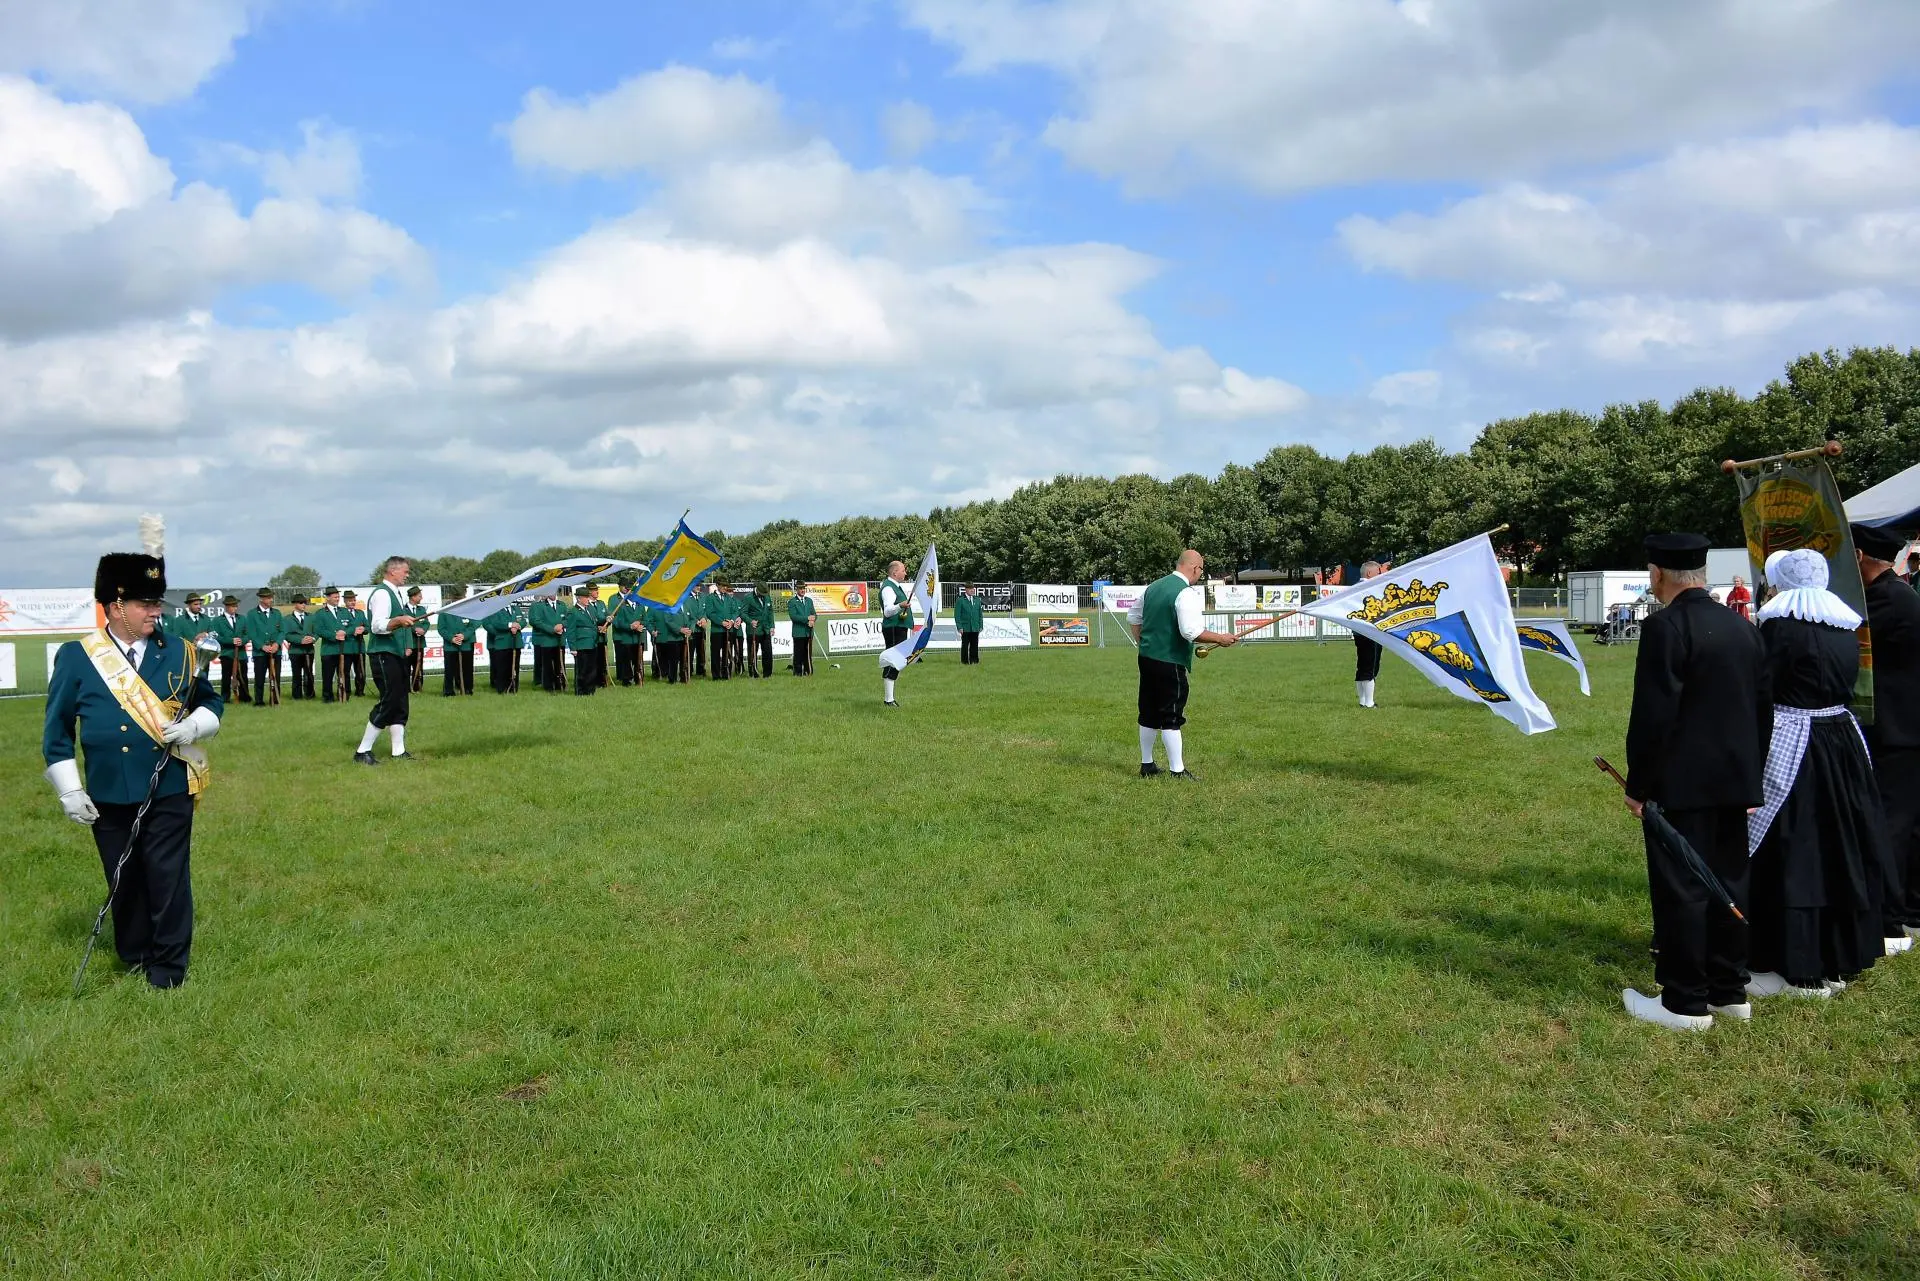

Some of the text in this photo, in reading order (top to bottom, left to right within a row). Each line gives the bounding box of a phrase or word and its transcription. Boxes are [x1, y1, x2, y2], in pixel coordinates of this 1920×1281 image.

[1623, 583, 1643, 591] Black
[1038, 592, 1075, 604] maribri
[830, 622, 859, 636] VIOS
